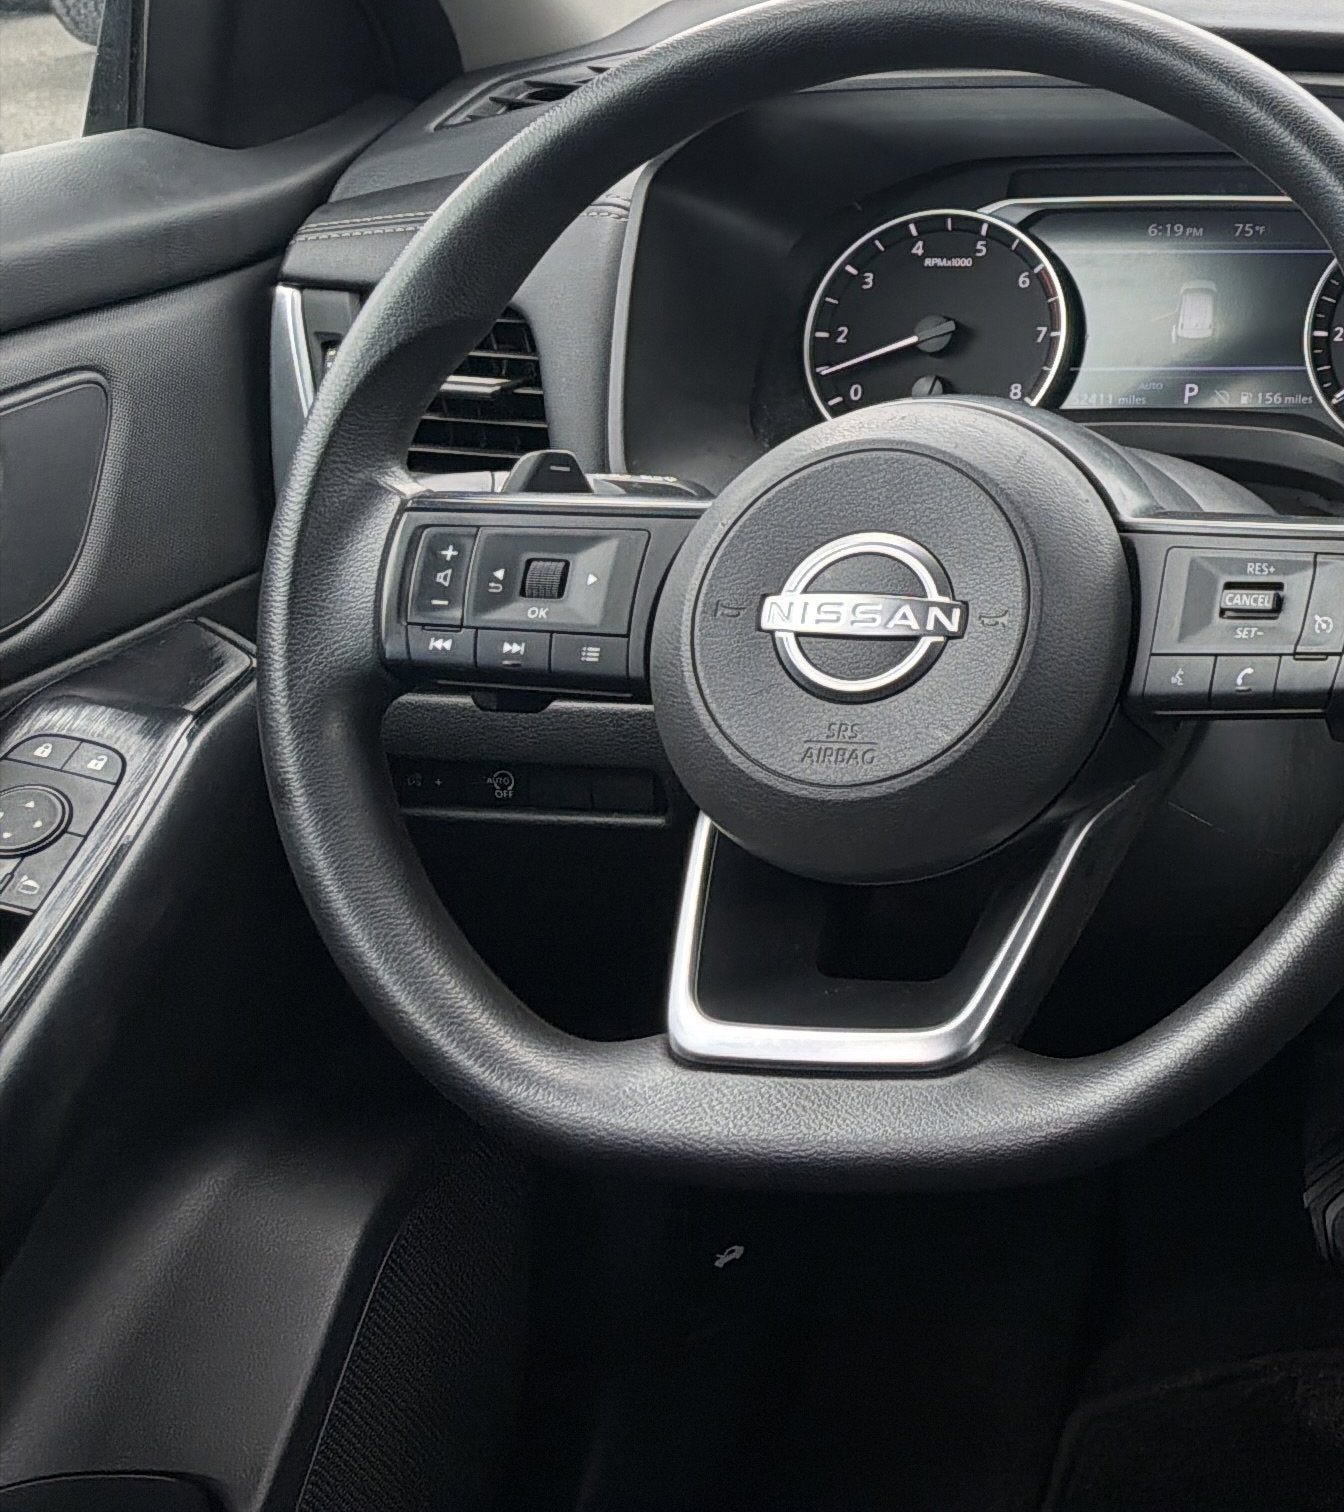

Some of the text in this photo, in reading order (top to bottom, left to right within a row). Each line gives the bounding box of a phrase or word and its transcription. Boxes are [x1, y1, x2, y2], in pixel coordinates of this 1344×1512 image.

[1147, 223, 1204, 238] 6:19 PM
[910, 240, 925, 257] 4
[975, 240, 988, 257] 5
[924, 257, 973, 268] RPMx1000
[861, 272, 875, 290] 3
[1017, 271, 1030, 288] 6
[836, 326, 849, 344] 2
[1035, 326, 1048, 343] 7
[850, 383, 863, 401] 0
[1009, 383, 1022, 400] 8
[1138, 381, 1164, 392] AUTO
[1183, 383, 1199, 405] P
[1118, 394, 1147, 406] miles
[1256, 392, 1314, 405] 156 miles
[1246, 562, 1276, 575] RES+
[1224, 593, 1271, 606] CANCEL
[527, 606, 549, 619] OK
[766, 600, 961, 632] NISSAN
[825, 722, 861, 740] SRS
[801, 746, 877, 765] AIRBAG
[494, 790, 515, 800] OFF
